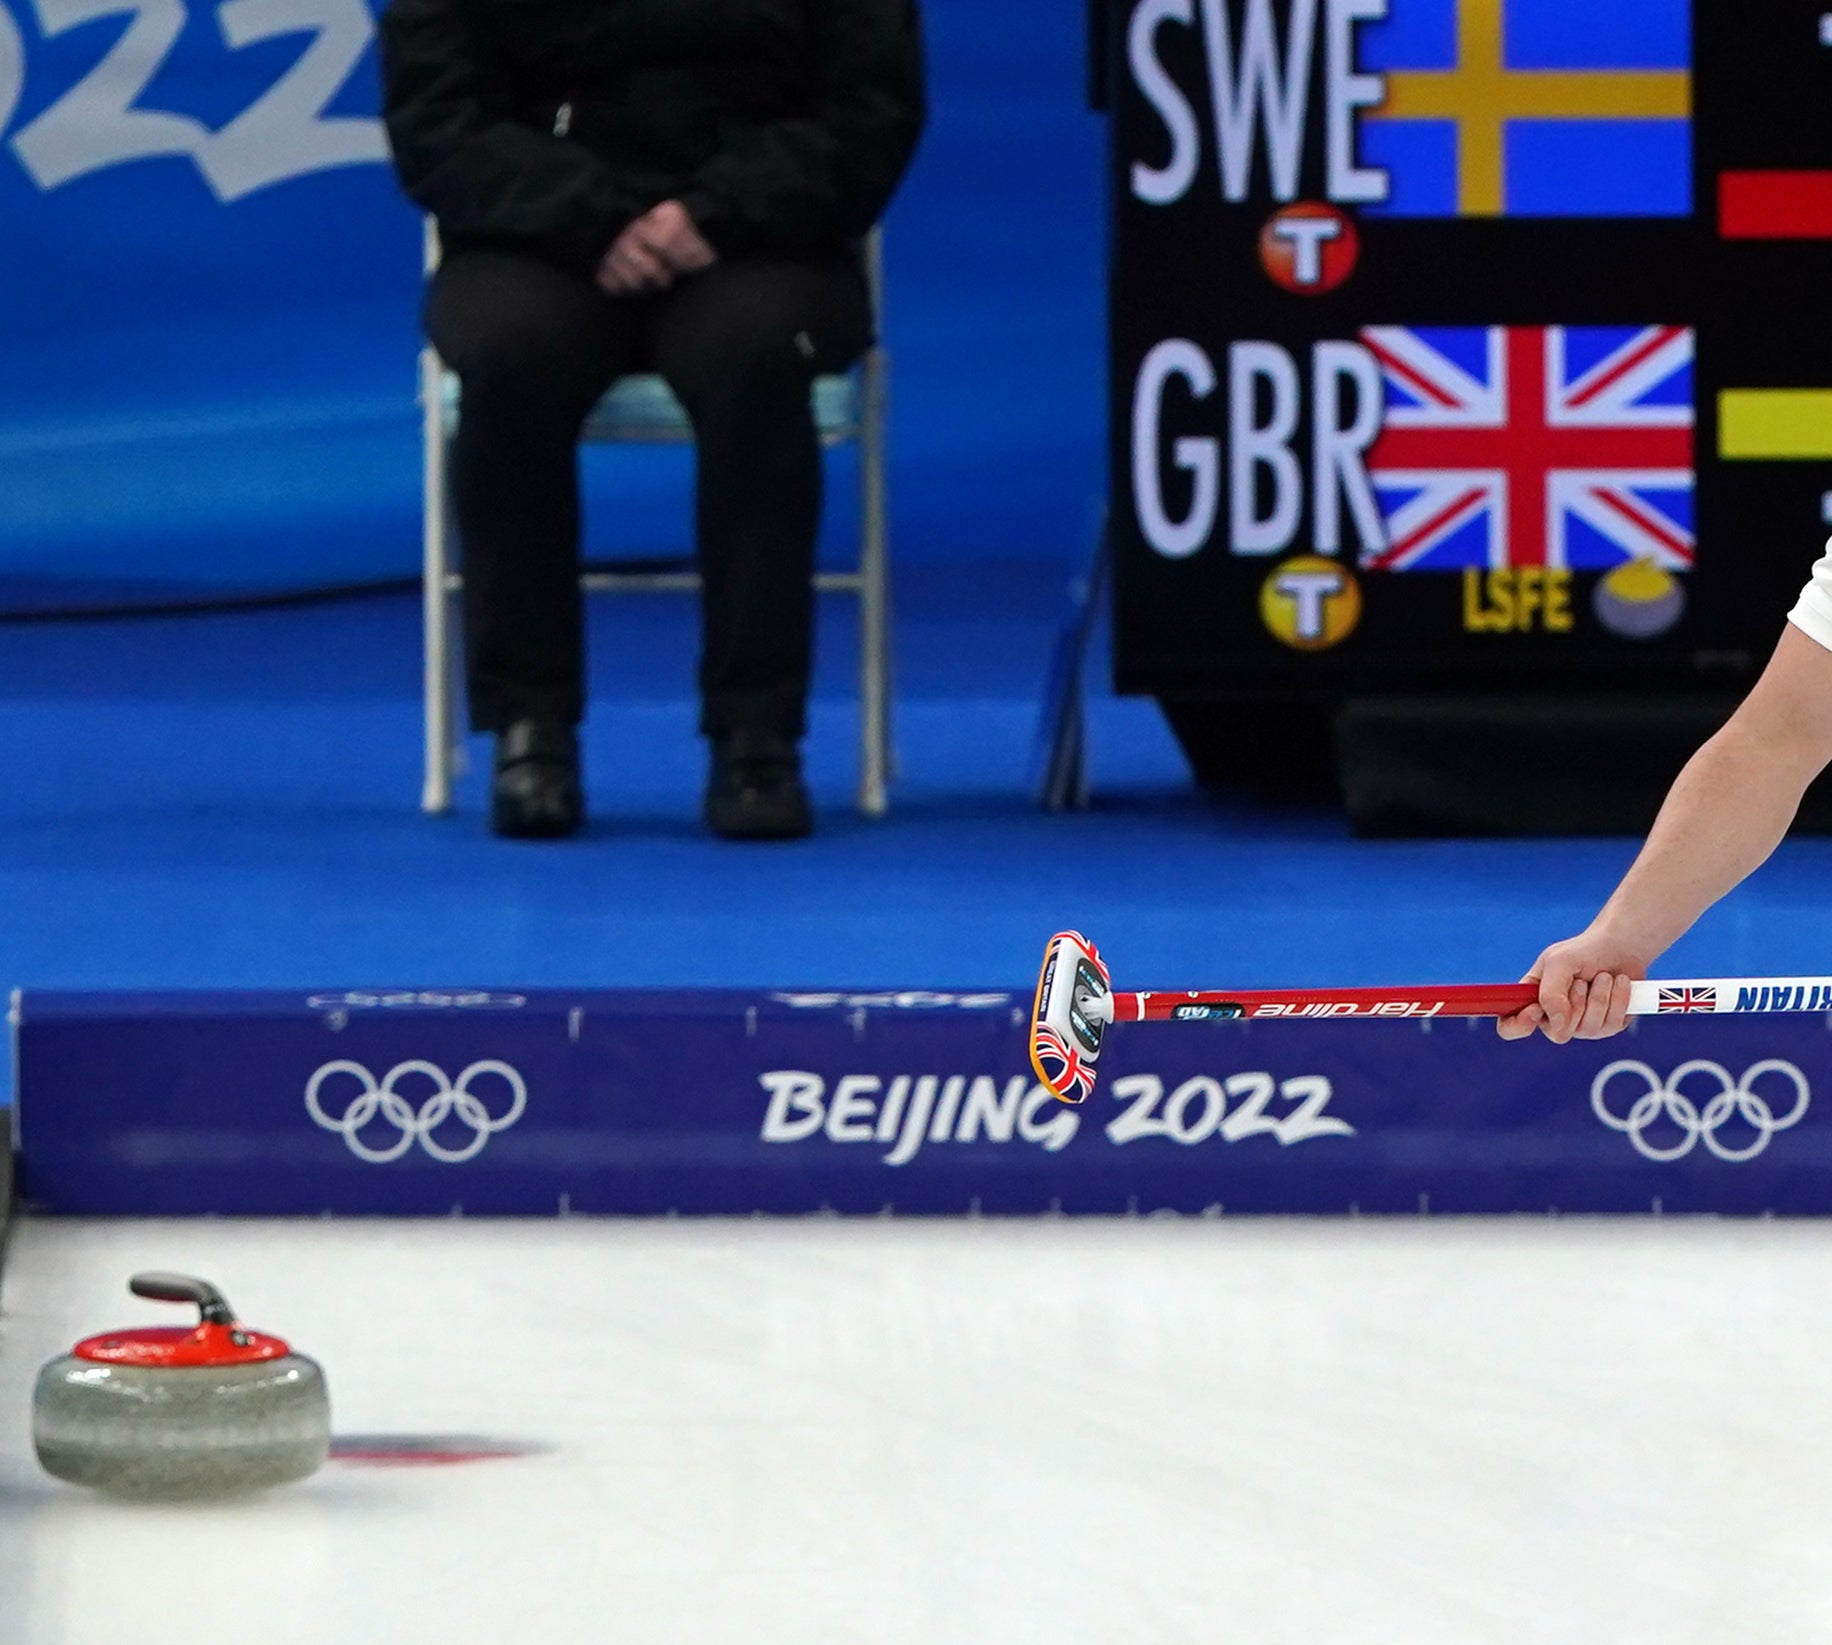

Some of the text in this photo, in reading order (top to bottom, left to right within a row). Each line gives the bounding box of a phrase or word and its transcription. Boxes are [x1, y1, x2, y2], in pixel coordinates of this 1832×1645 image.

[1128, 0, 1390, 205] SWE
[1131, 337, 1388, 558] GBR
[1463, 567, 1573, 633] LSFE
[758, 1070, 1355, 1167] BEIJING 2022
